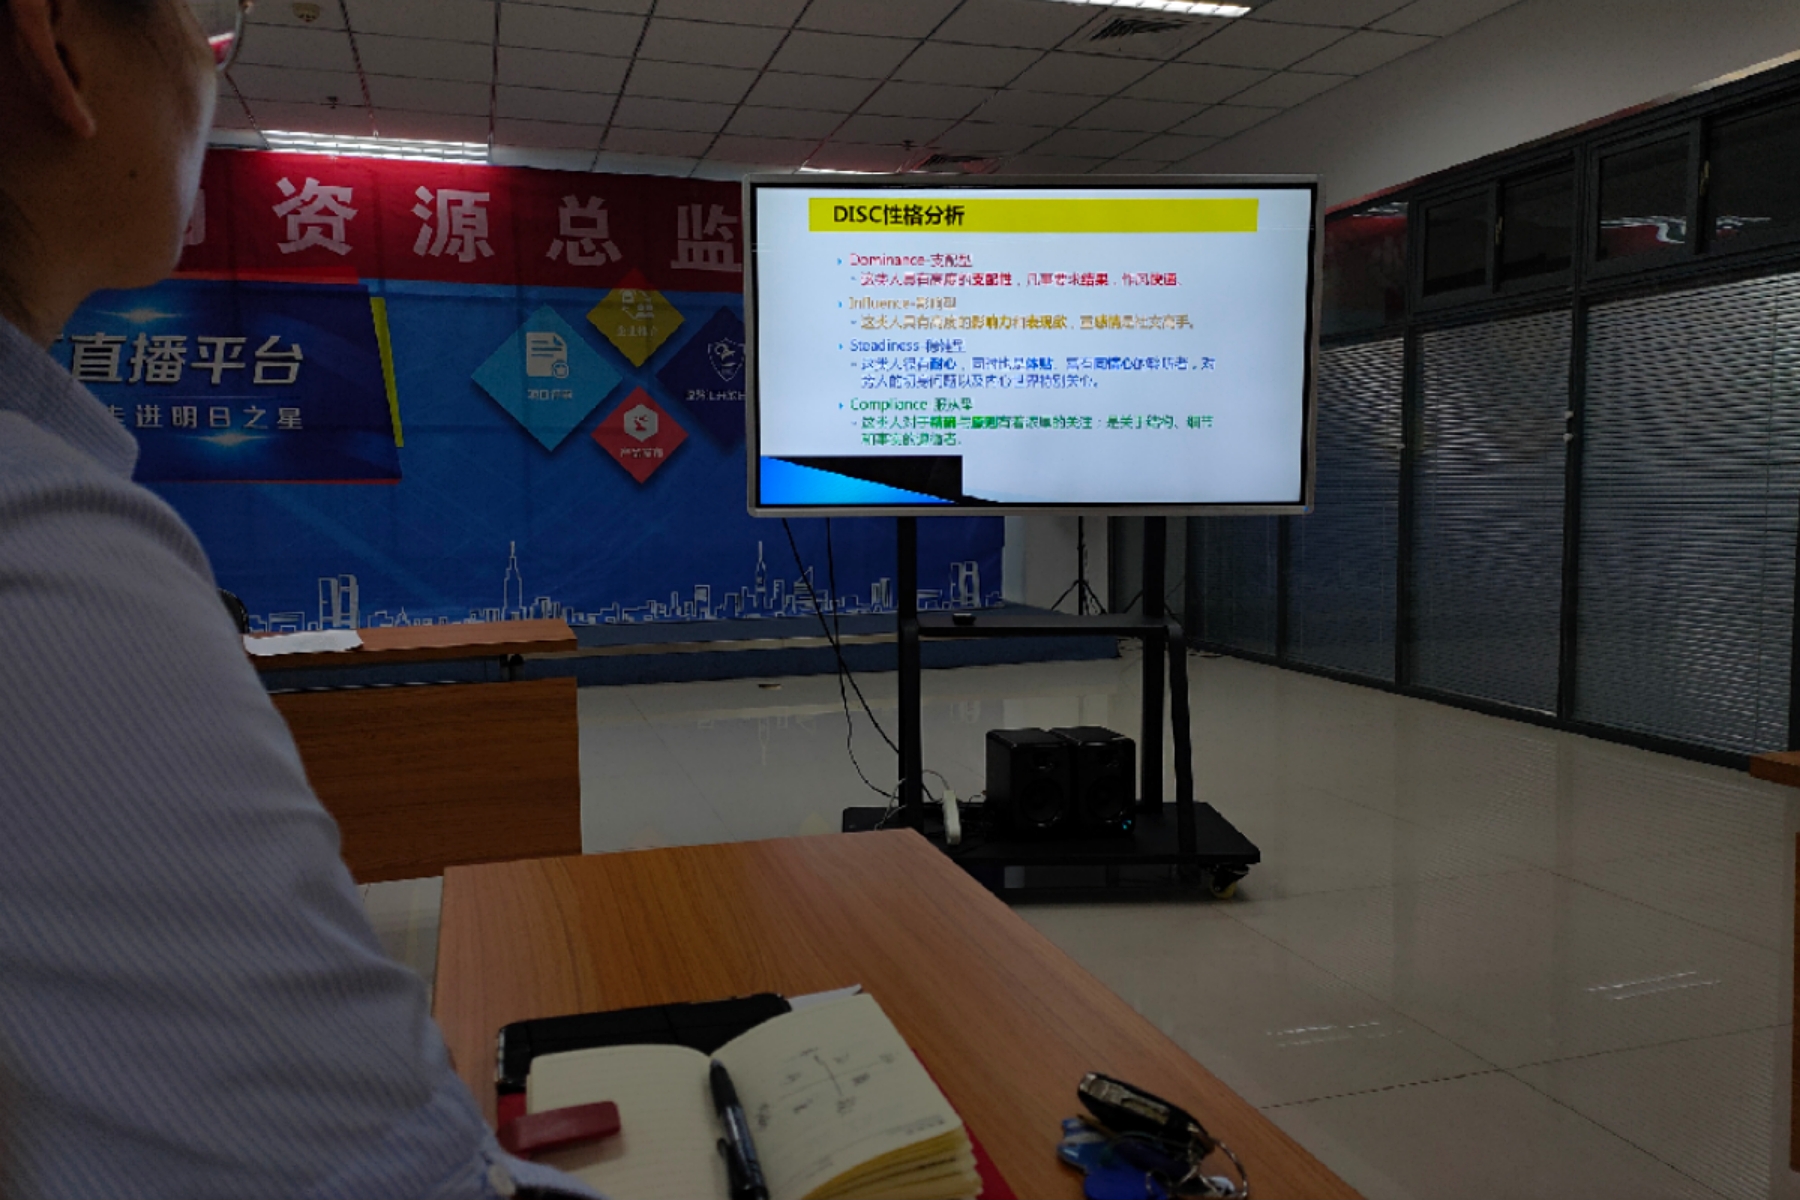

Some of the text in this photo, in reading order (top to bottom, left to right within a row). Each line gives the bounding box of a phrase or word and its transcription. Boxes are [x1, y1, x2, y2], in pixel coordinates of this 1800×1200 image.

[182, 176, 743, 273] 资源总监
[833, 203, 965, 226] DISC性格分析
[54, 330, 304, 386] 直播平台
